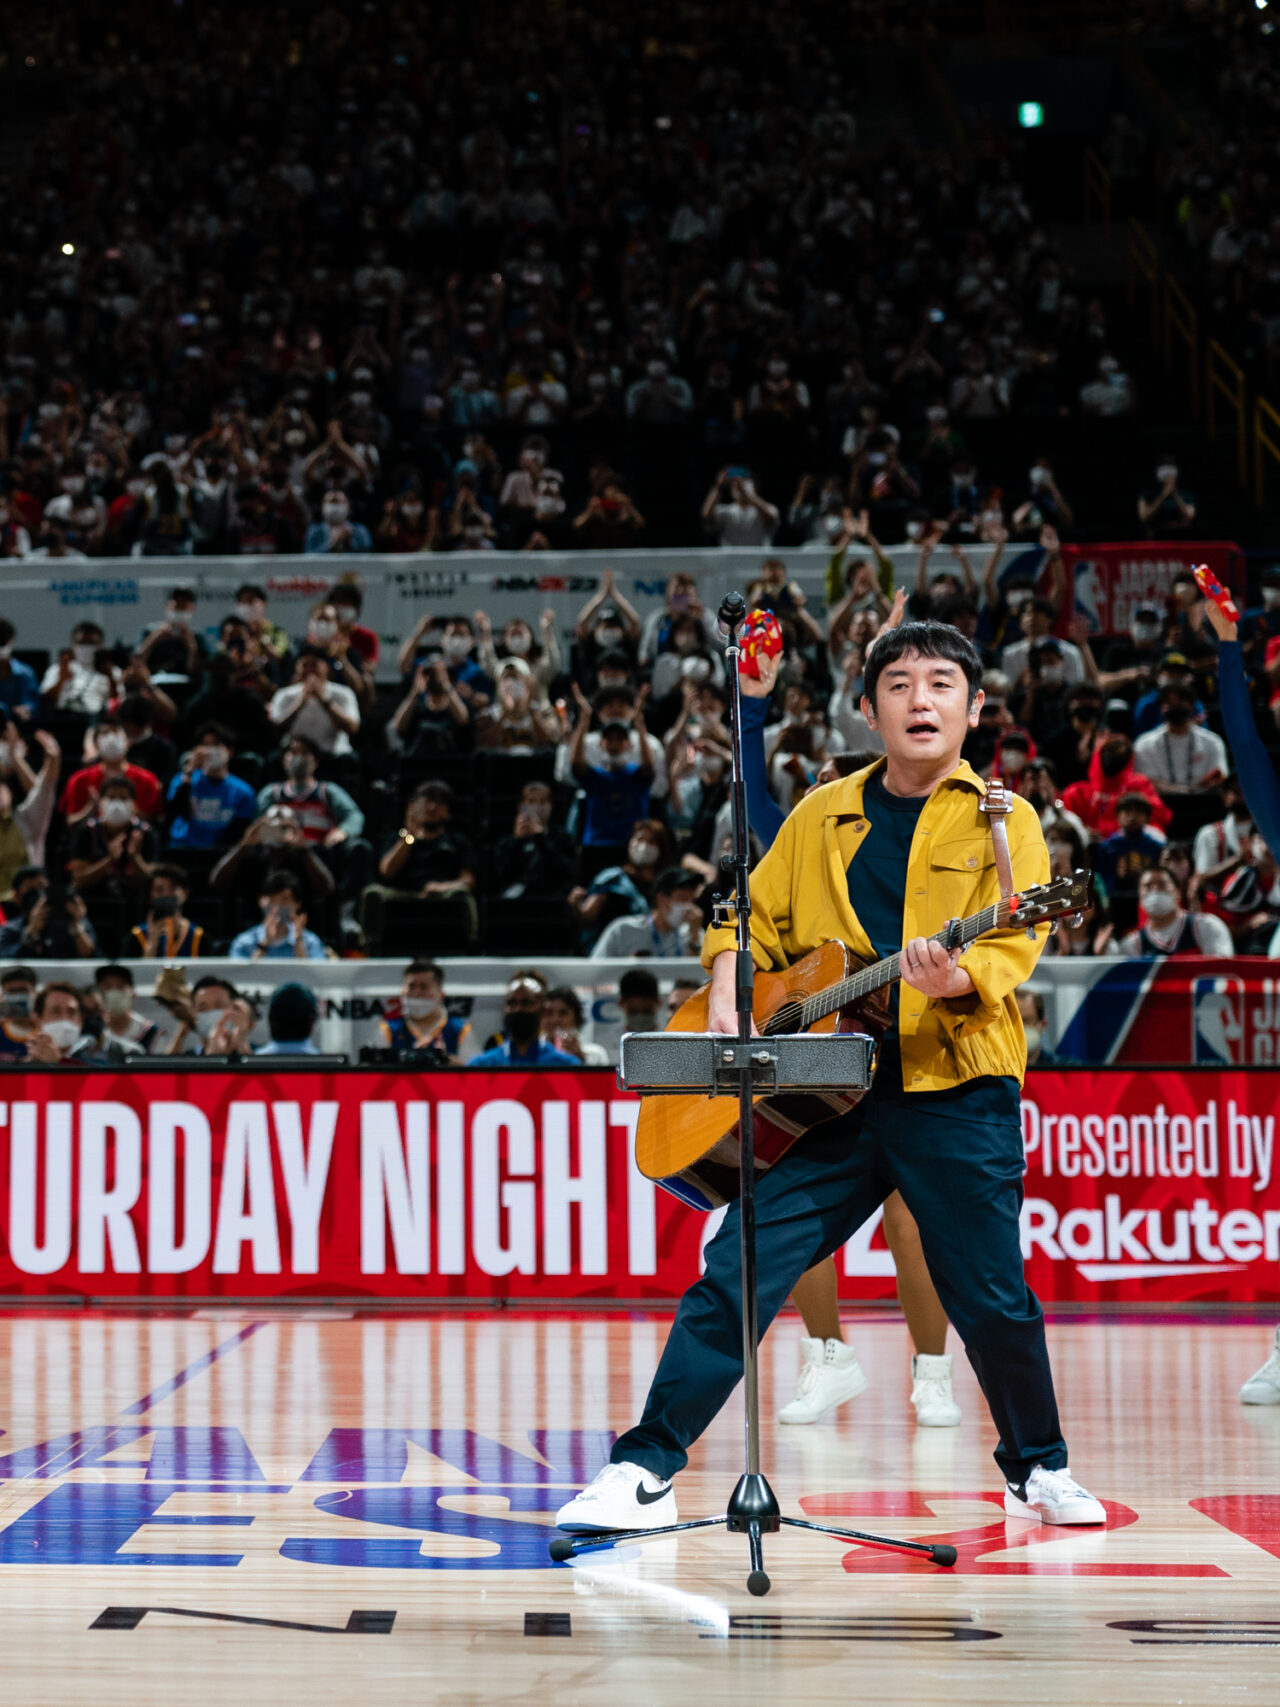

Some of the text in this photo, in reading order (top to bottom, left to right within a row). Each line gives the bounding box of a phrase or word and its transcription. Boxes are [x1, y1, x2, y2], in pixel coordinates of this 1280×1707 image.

[361, 1099, 658, 1276] NIGHT
[1020, 1099, 1275, 1192] Presented by
